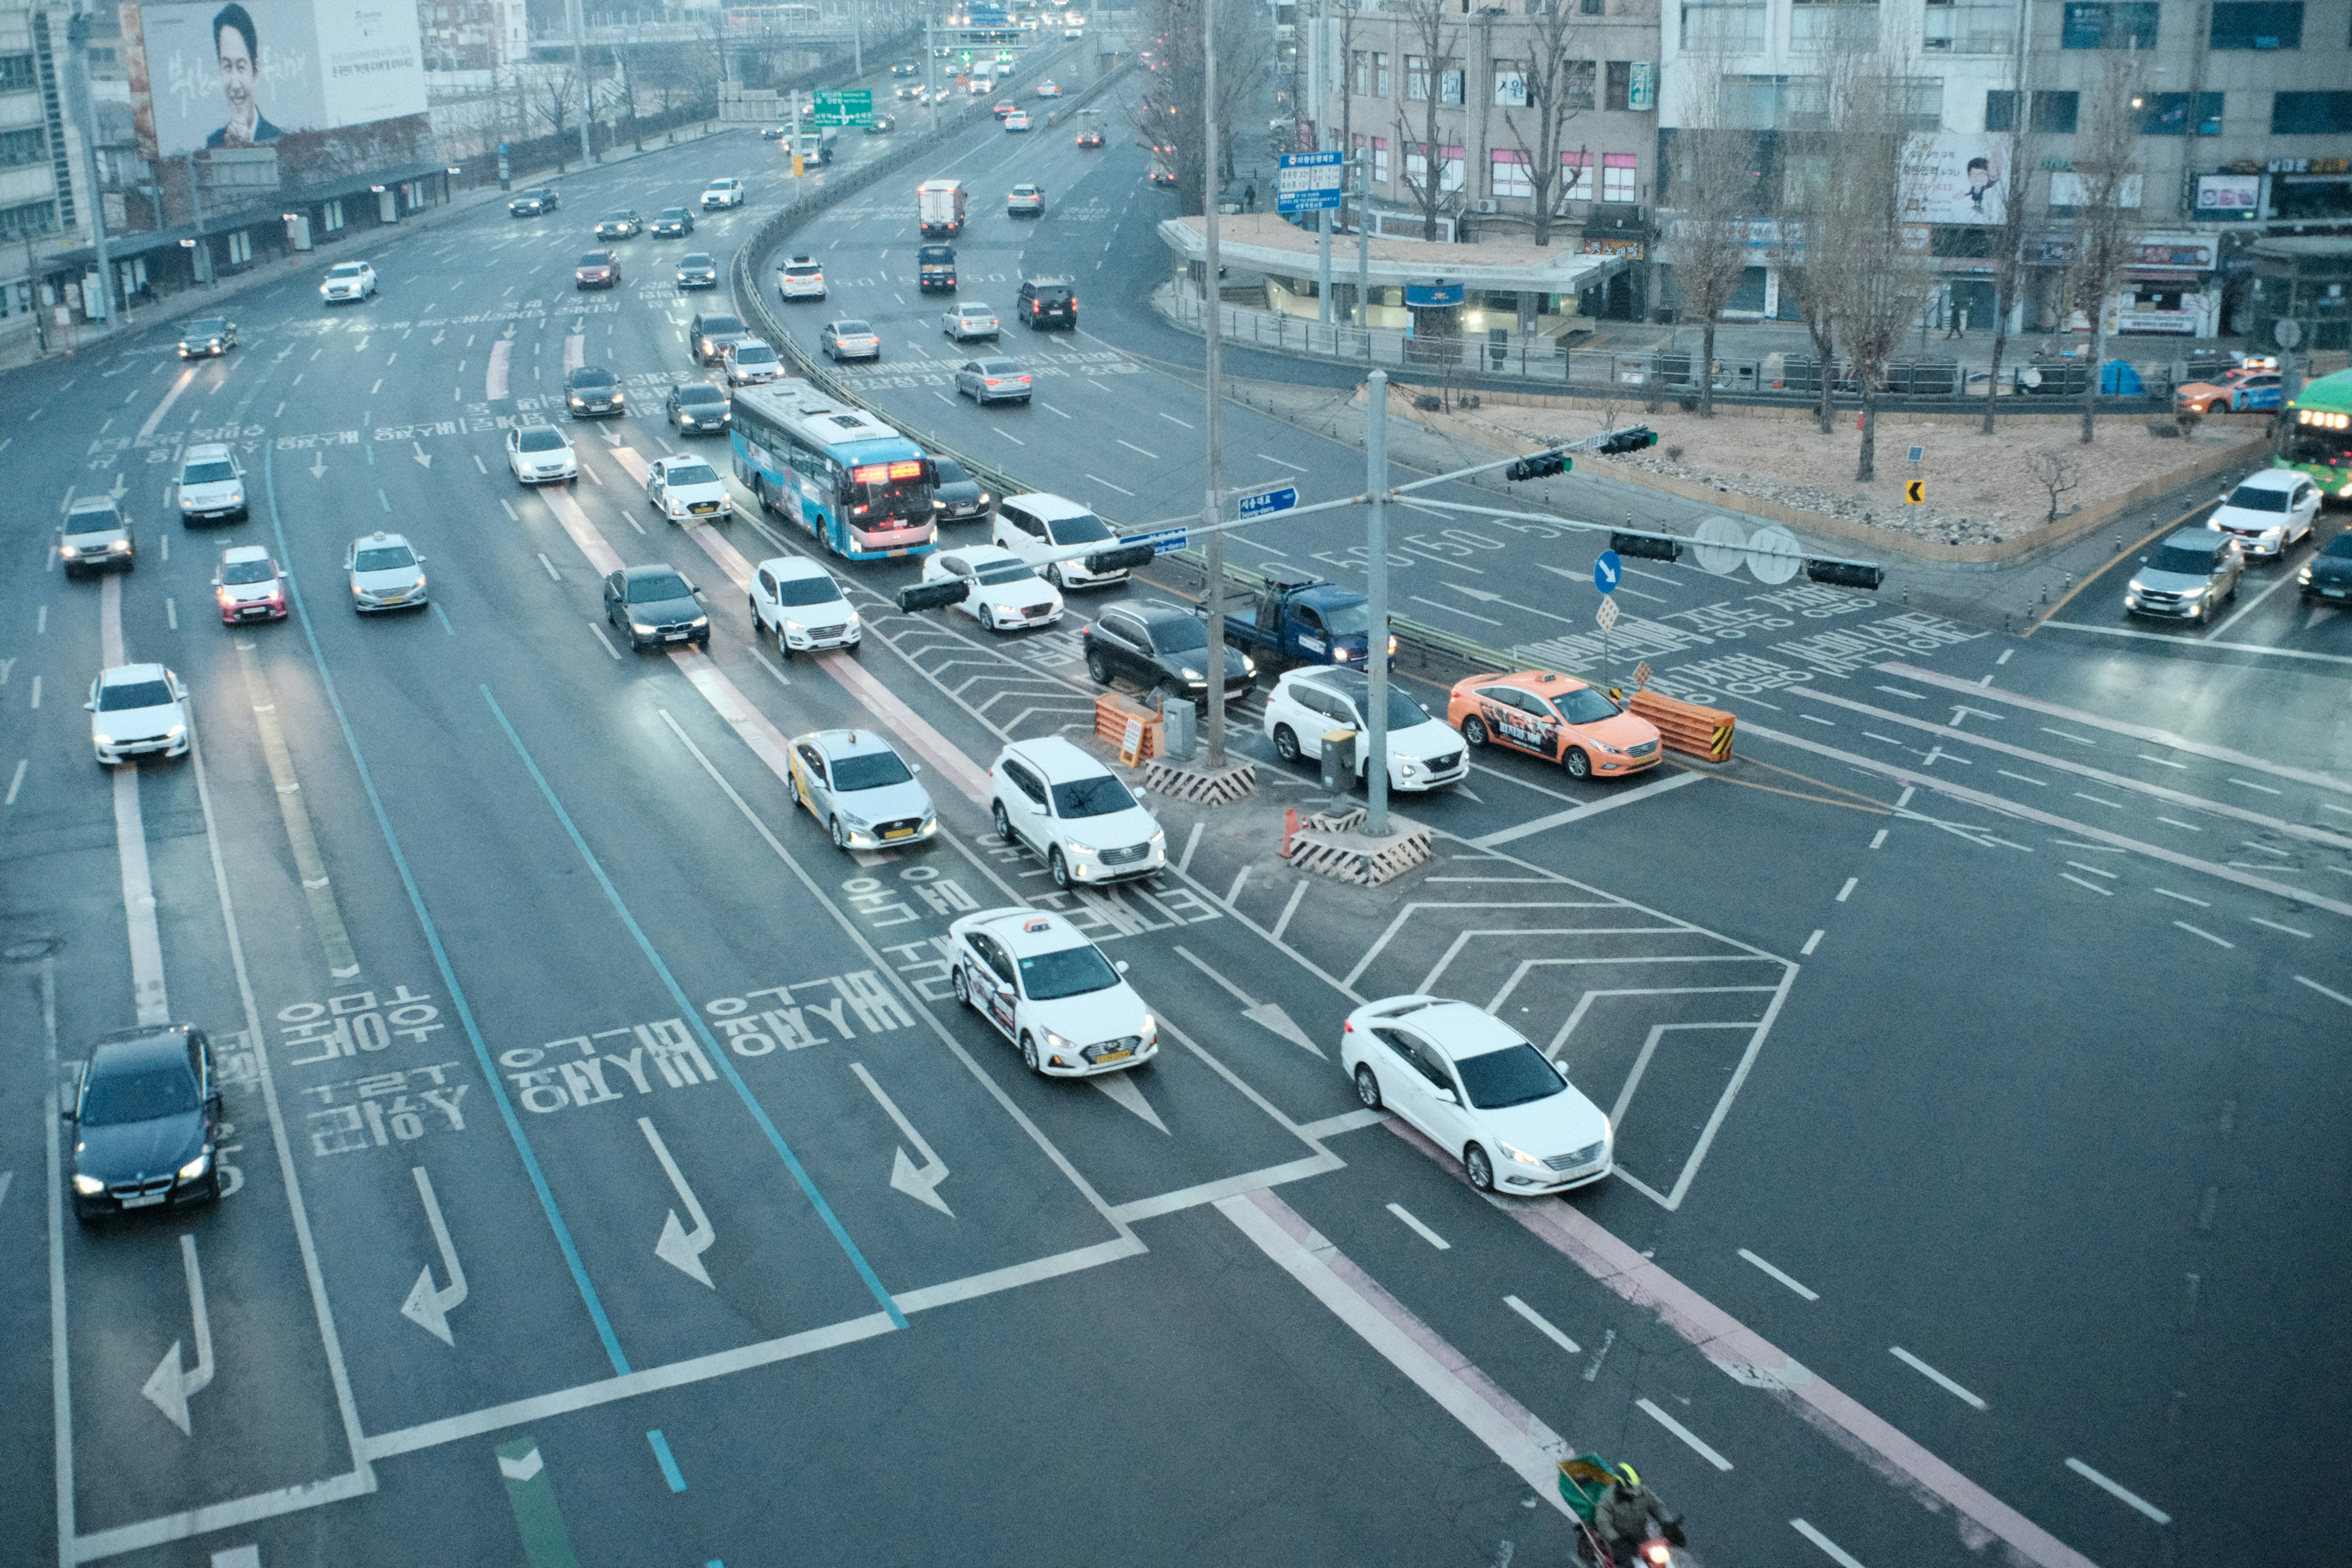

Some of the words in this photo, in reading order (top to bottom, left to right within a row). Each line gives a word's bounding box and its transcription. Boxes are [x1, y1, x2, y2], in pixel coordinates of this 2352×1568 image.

[277, 430, 358, 450] 버스전용
[373, 418, 456, 441] 버스전용
[1242, 495, 1271, 510] 세종대로
[1404, 529, 1506, 556] 50
[1657, 602, 1795, 639] 공덕동
[1744, 584, 1878, 618] 경찰청
[1664, 653, 1814, 694] 경찰청
[1767, 631, 1906, 679] 서부역
[1855, 612, 1994, 649] 숭례문
[842, 866, 981, 929] 명동
[277, 986, 445, 1067] 후암동
[706, 970, 916, 1057] 버스전용
[500, 1018, 718, 1114] 버스전용
[301, 1061, 469, 1159] 소월로
